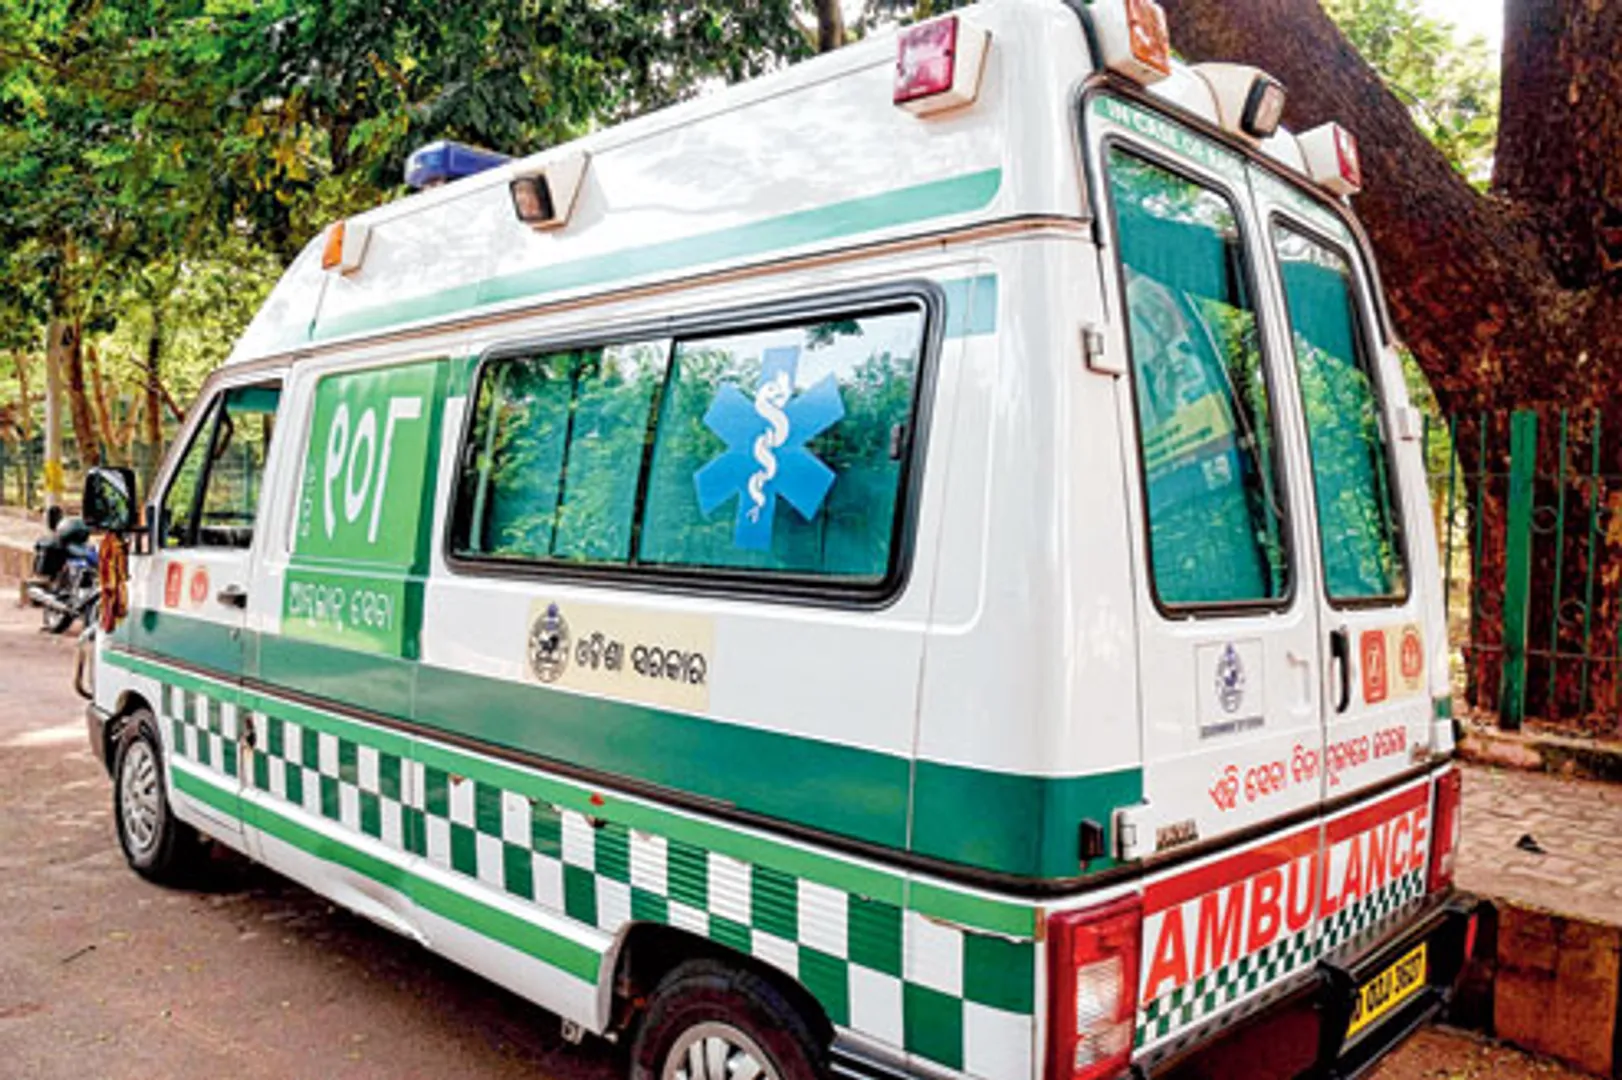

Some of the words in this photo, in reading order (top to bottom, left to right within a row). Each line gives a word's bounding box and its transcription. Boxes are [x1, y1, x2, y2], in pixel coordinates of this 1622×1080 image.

[630, 644, 708, 685] ସରକାର
[1208, 764, 1239, 812] ଏହି
[1142, 804, 1429, 1008] AMBULANCE
